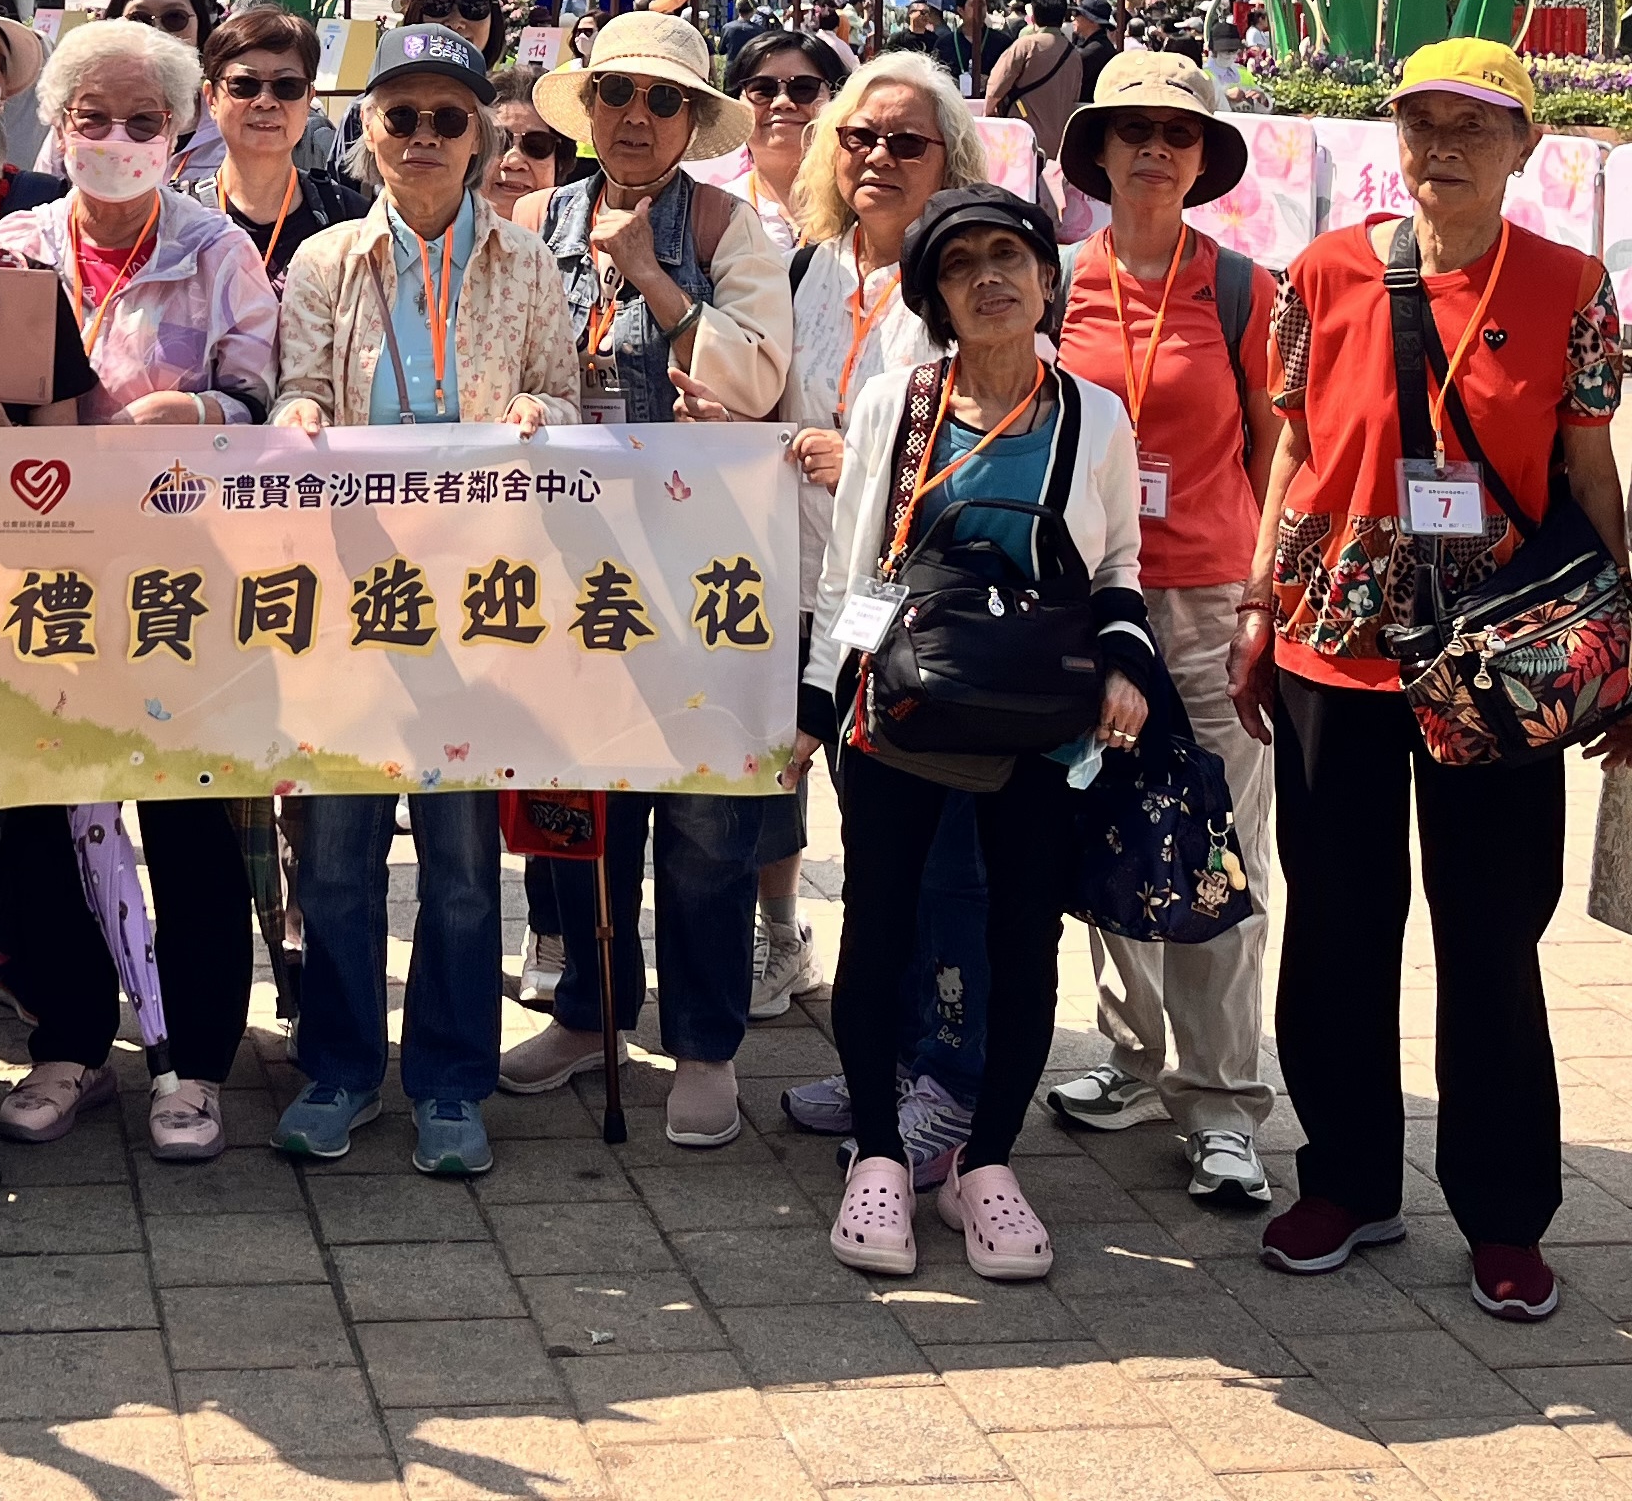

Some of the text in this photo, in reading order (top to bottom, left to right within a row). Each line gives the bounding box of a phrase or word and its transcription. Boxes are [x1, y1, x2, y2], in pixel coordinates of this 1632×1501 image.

[429, 46, 469, 69] OPEN
[528, 43, 547, 58] $14
[1353, 163, 1415, 211] 香港
[222, 469, 602, 511] 禮賢會沙田長者鄰舍中心
[1438, 497, 1452, 519] 7
[2, 555, 771, 660] 禮賢同遊迎春花
